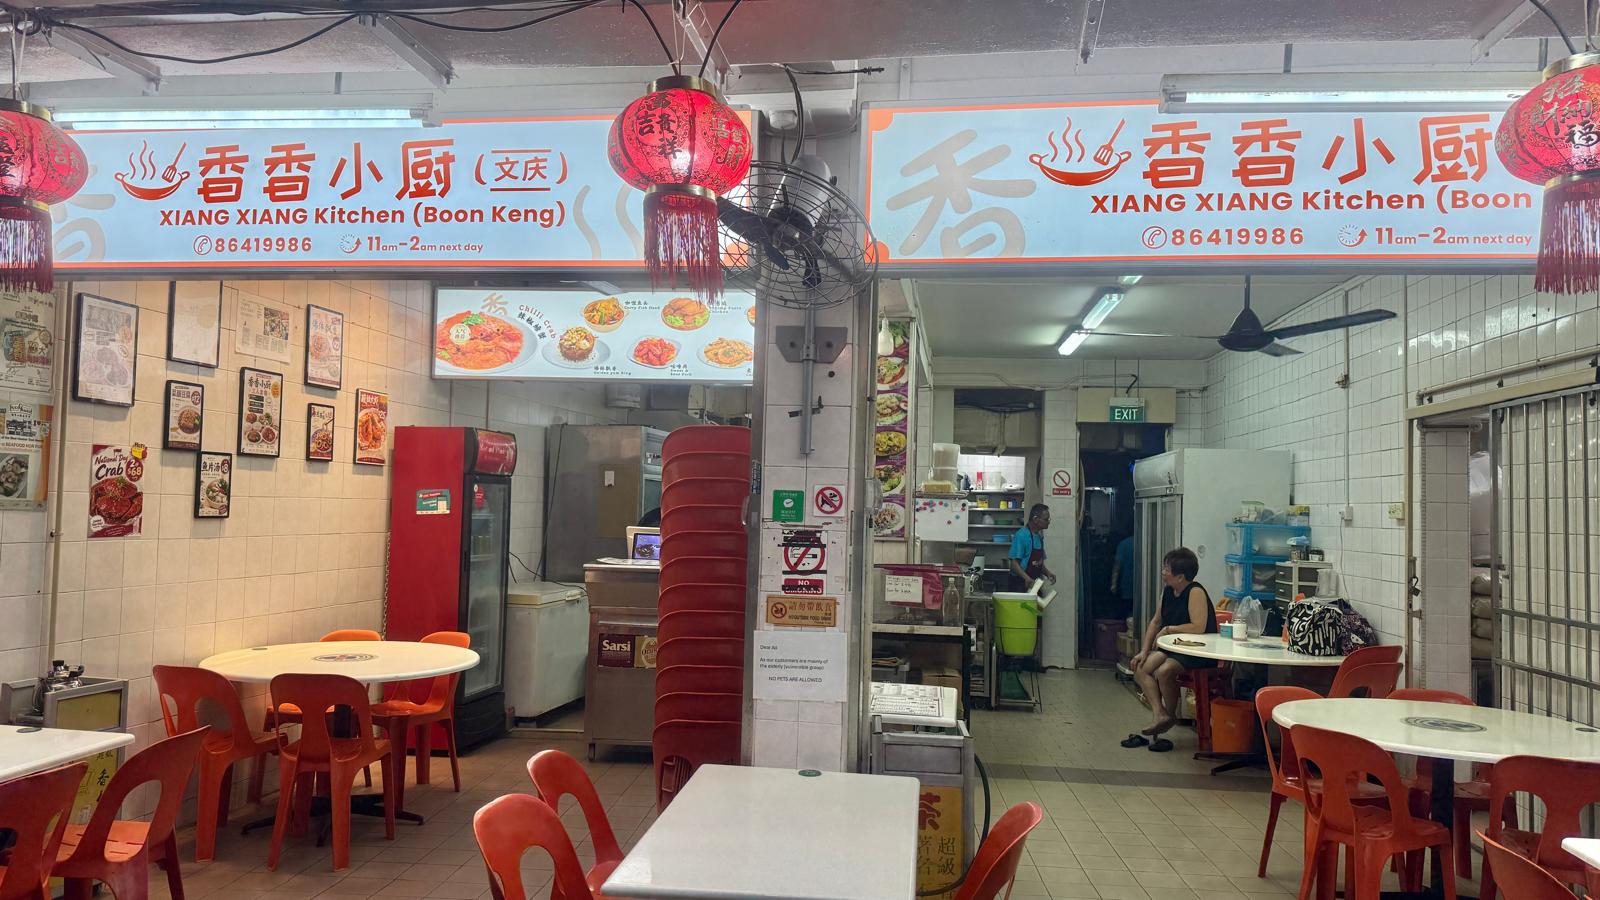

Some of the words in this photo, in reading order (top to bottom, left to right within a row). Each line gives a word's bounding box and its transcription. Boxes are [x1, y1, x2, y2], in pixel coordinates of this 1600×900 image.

[1143, 113, 1493, 189] 香香小厨
[197, 138, 456, 203] 香香小厨
[1091, 194, 1186, 214] XIANG
[1195, 191, 1293, 212] XIANG
[1302, 188, 1426, 211] Kitchen
[1437, 185, 1532, 214] (Boon
[160, 209, 230, 226] XIANG
[236, 207, 309, 225] XIANG
[314, 206, 405, 225] Kitchen
[413, 202, 484, 227] (Boon
[491, 201, 566, 228] Keng)
[215, 236, 313, 253] 86419986
[1171, 227, 1305, 247] 86419986
[1473, 235, 1511, 245] next
[1512, 233, 1533, 247] day
[439, 244, 462, 252] next
[464, 242, 484, 253] day
[519, 304, 544, 319] Chilli
[543, 320, 556, 339] Crab
[1114, 408, 1138, 420] EXIT
[95, 454, 118, 465] National
[119, 455, 129, 464] Day
[95, 463, 124, 480] Crab
[127, 466, 142, 476] $68
[602, 639, 631, 652] Sarsi
